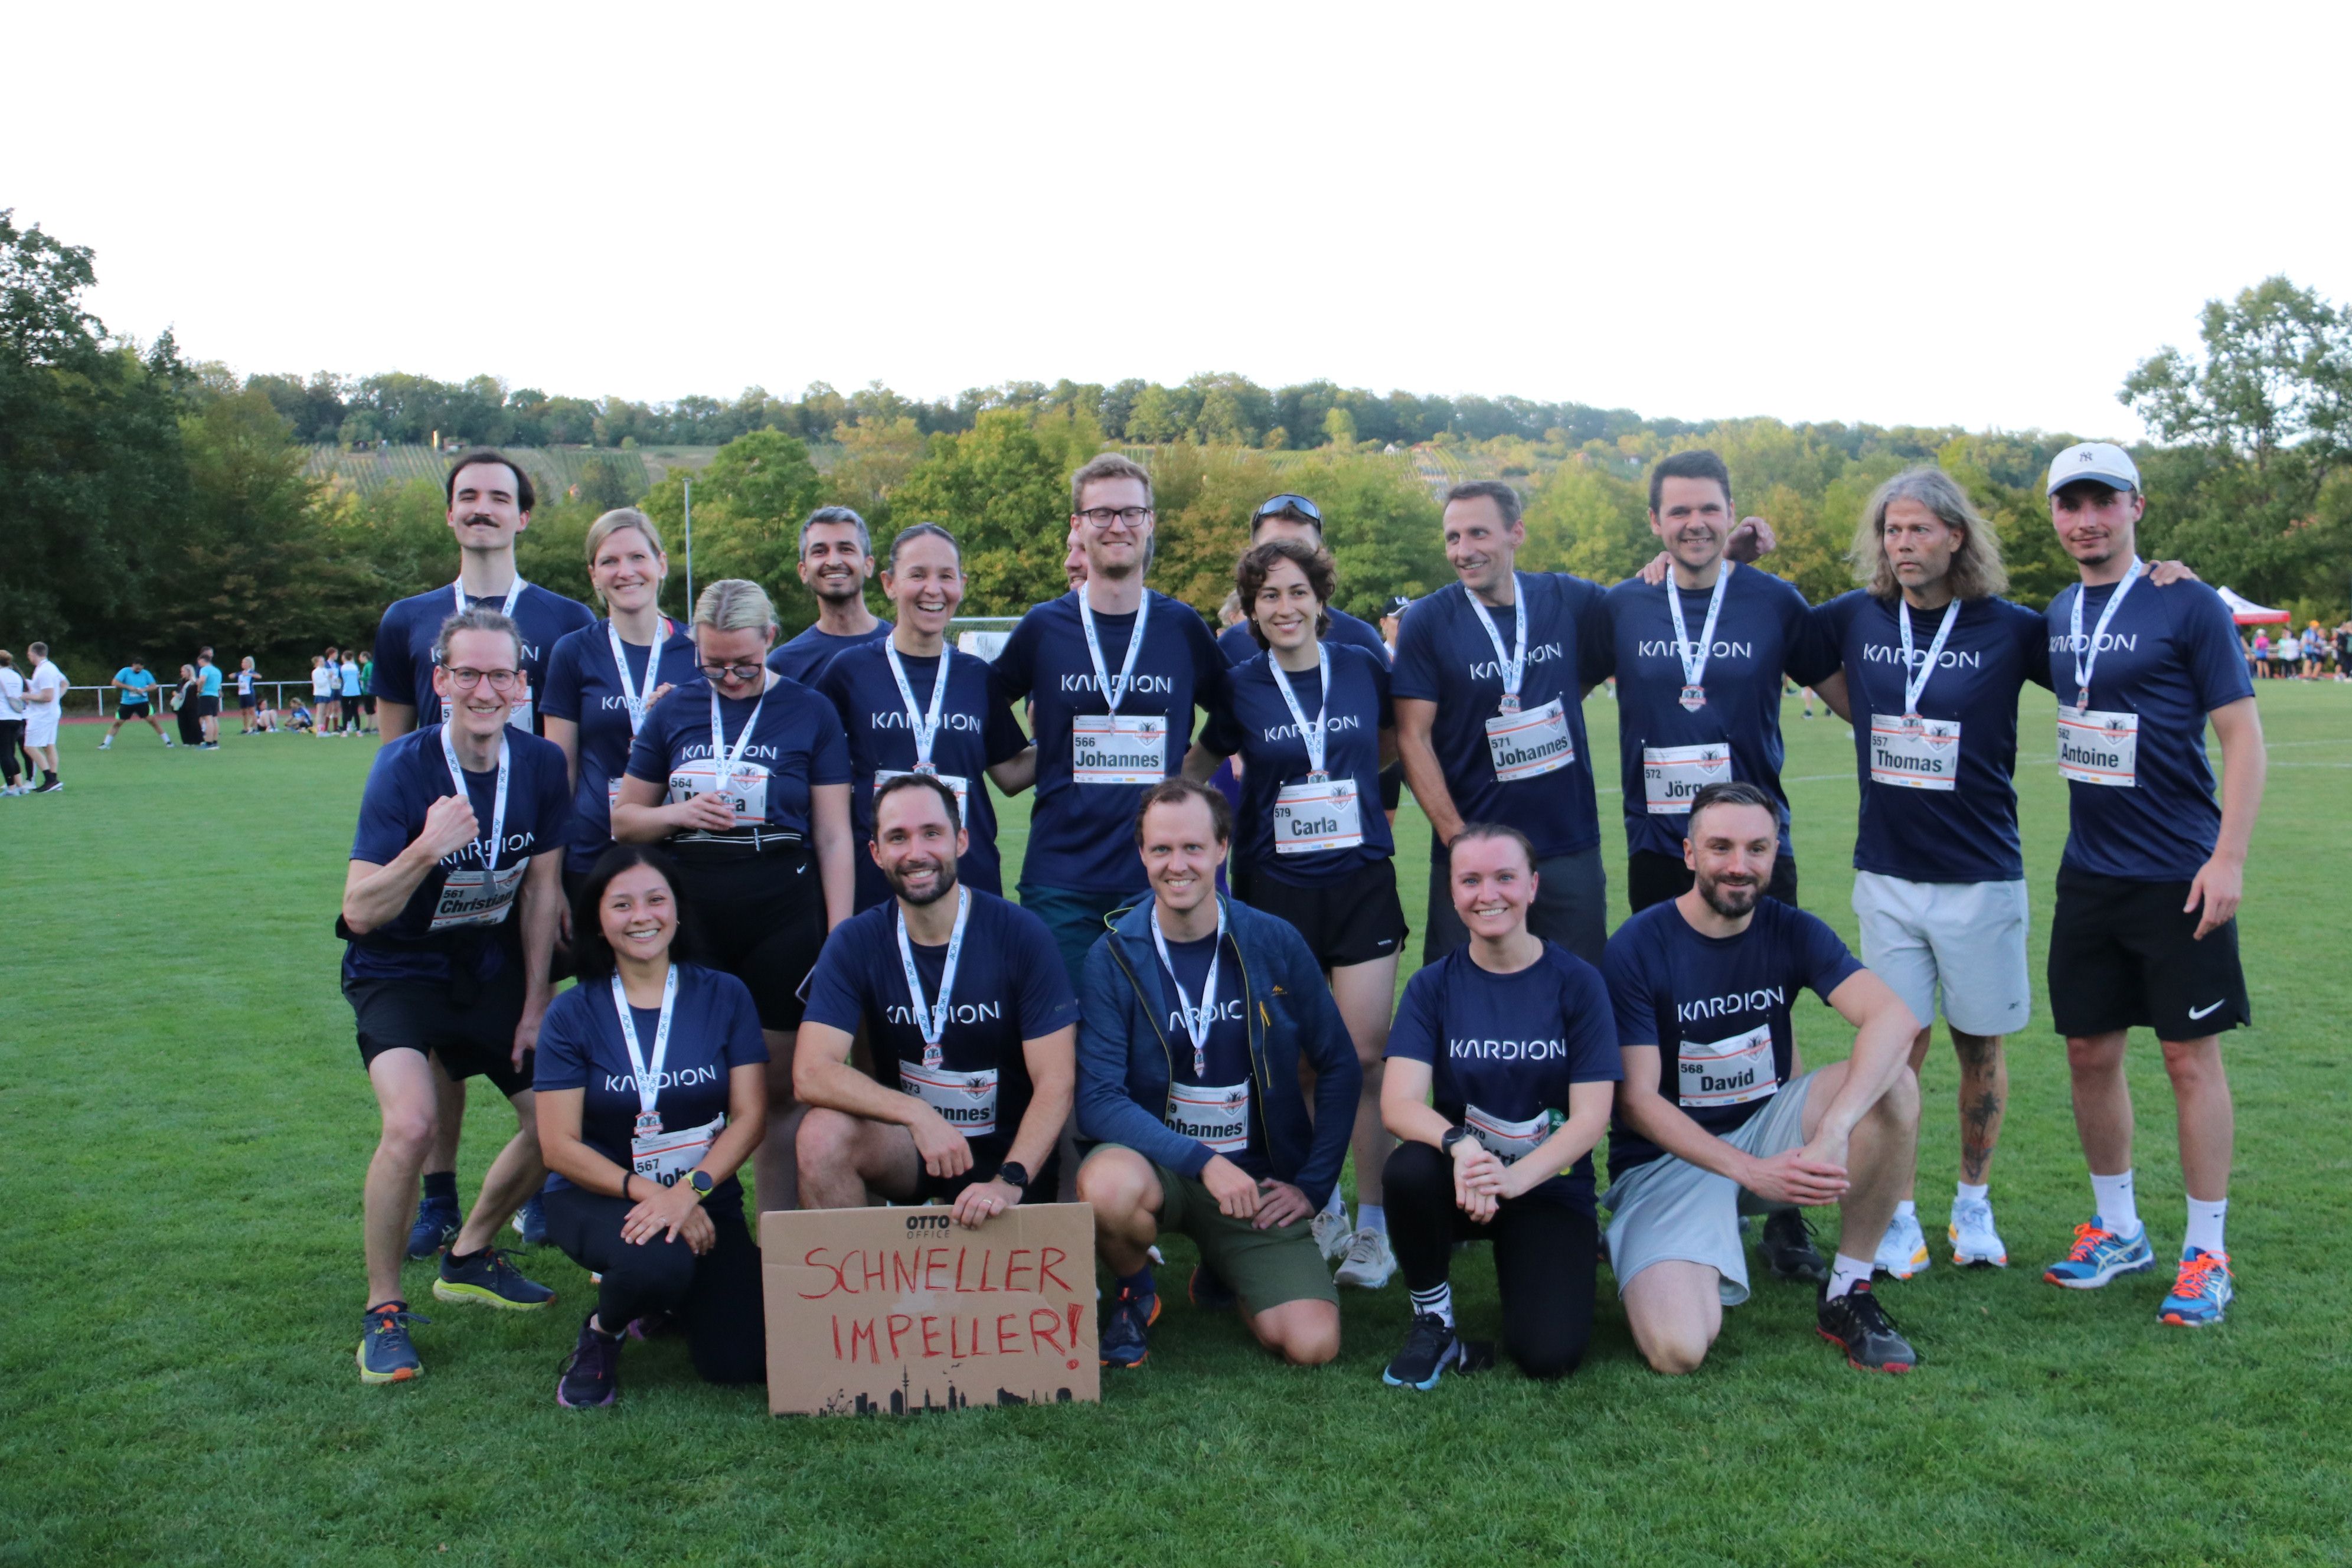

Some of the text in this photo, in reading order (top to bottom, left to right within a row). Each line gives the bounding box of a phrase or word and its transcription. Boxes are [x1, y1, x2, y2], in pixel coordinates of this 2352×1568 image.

[1711, 596, 1719, 614] AOK
[2109, 596, 2119, 612] AOK
[1085, 623, 1094, 639] AOK
[1485, 622, 1497, 635] AOK
[1673, 615, 1683, 631] AOK
[1131, 633, 1140, 649] AOK
[1903, 631, 1911, 646] AOK
[1932, 639, 1942, 655] AOK
[1697, 642, 1707, 658] AOK
[1502, 664, 1511, 681] AOK
[1513, 658, 1521, 675] AOK
[1683, 660, 1693, 679] AOK
[898, 678, 908, 692] AOK
[1097, 669, 1107, 686] AOK
[1118, 678, 1126, 693] AOK
[934, 686, 942, 701] AOK
[1283, 690, 1295, 704] AOK
[1910, 683, 1922, 699] AOK
[743, 724, 752, 737] AOK
[914, 722, 923, 737] AOK
[924, 730, 933, 747] AOK
[1075, 737, 1096, 747] 566
[1304, 732, 1314, 748] AOK
[1491, 736, 1511, 749] 571
[1871, 736, 1888, 747] 557
[1075, 750, 1159, 767] Johannes
[1495, 736, 1568, 767] Johannes
[2062, 742, 2119, 768] Antoine
[449, 757, 459, 773] AOK
[1876, 749, 1942, 773] Thomas
[724, 764, 733, 776] AOK
[1645, 769, 1661, 779] 572
[671, 777, 692, 788] 564
[1275, 808, 1292, 818] 579
[492, 818, 501, 835] AOK
[1291, 816, 1338, 837] Carla
[440, 890, 513, 914] Christian
[443, 889, 464, 899] 561
[949, 943, 959, 961] AOK
[904, 959, 915, 976] AOK
[667, 972, 676, 989] AOK
[938, 997, 947, 1015] AOK
[1677, 986, 1784, 1023] KARDION
[621, 1013, 632, 1030] AOK
[919, 1013, 929, 1030] AOK
[1183, 1005, 1193, 1023] AOK
[1201, 1013, 1210, 1032] AOK
[658, 1023, 667, 1040] AOK
[1450, 1038, 1567, 1060] KARDION
[635, 1064, 646, 1083] AOK
[1680, 1063, 1704, 1074] 568
[648, 1076, 658, 1095] AOK
[1700, 1067, 1755, 1092] David
[1465, 1123, 1486, 1140] 570
[636, 1158, 659, 1173] 567
[906, 1214, 950, 1230] OTTO
[907, 1230, 950, 1239] OFFICE
[797, 1245, 1073, 1299] SCHNELLER
[831, 1302, 1084, 1370] IMPELLER!
